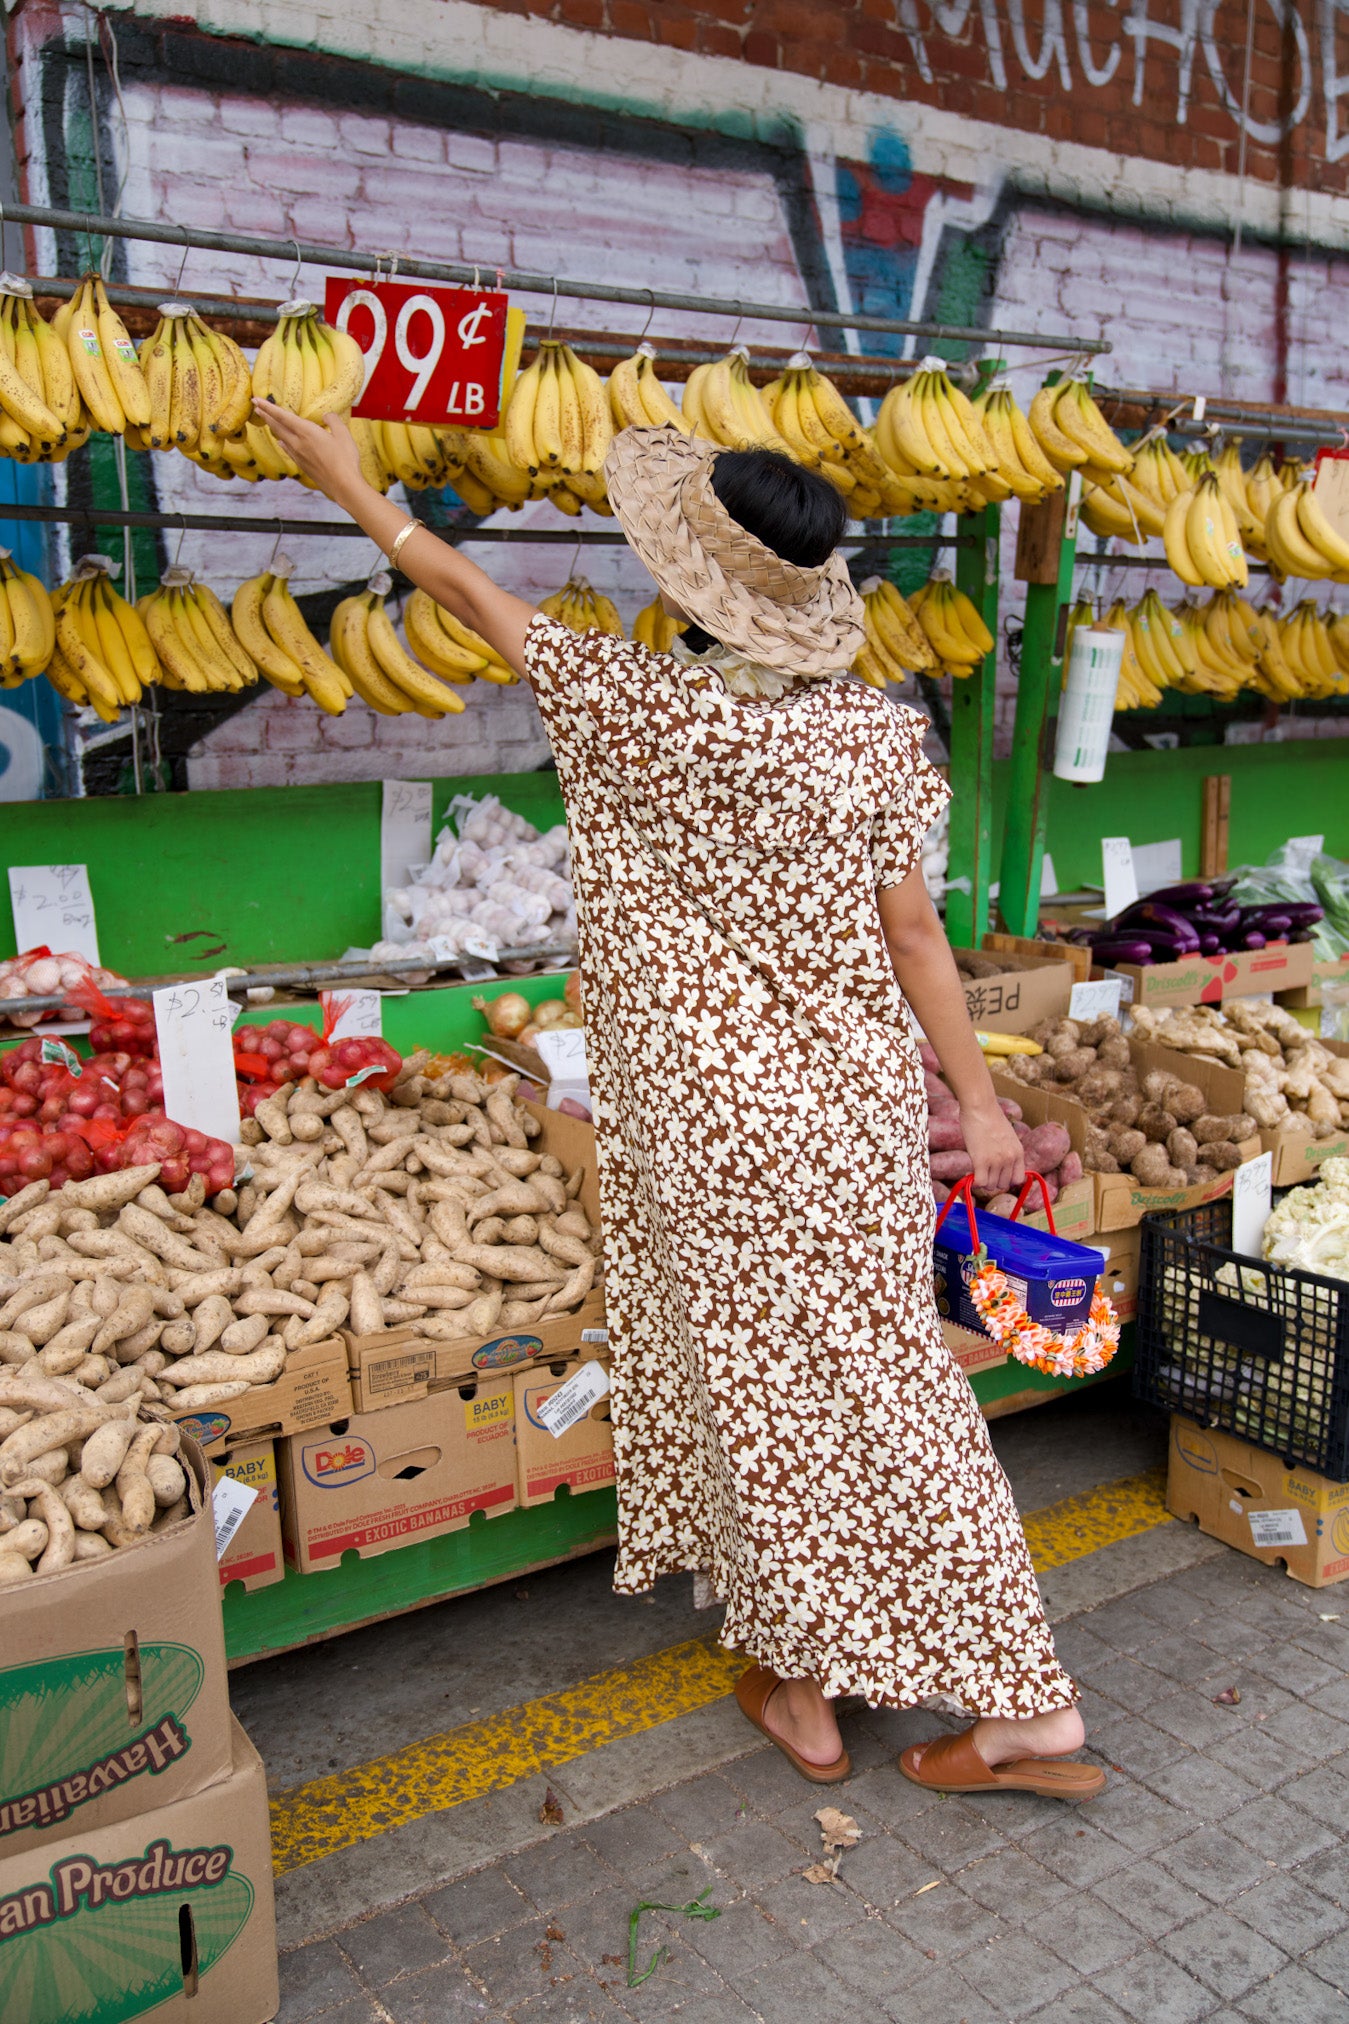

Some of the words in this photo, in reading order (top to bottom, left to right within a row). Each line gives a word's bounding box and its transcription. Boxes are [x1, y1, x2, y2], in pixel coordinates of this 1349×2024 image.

[446, 382, 485, 415] LB
[473, 1396, 507, 1415] BABY
[466, 1424, 498, 1440] PRODUCT
[499, 1421, 509, 1430] OF
[477, 1429, 509, 1445] ECUADOR
[315, 1444, 366, 1473] Dole
[225, 1459, 266, 1479] BABY
[575, 1463, 613, 1485] EXOTIC
[1288, 1478, 1316, 1497] BABY
[353, 1518, 372, 1530] DOLE
[371, 1513, 392, 1525] FRESH
[365, 1519, 408, 1543] EXOTIC
[410, 1502, 466, 1530] BANANAS
[58, 1845, 229, 1913] Produce
